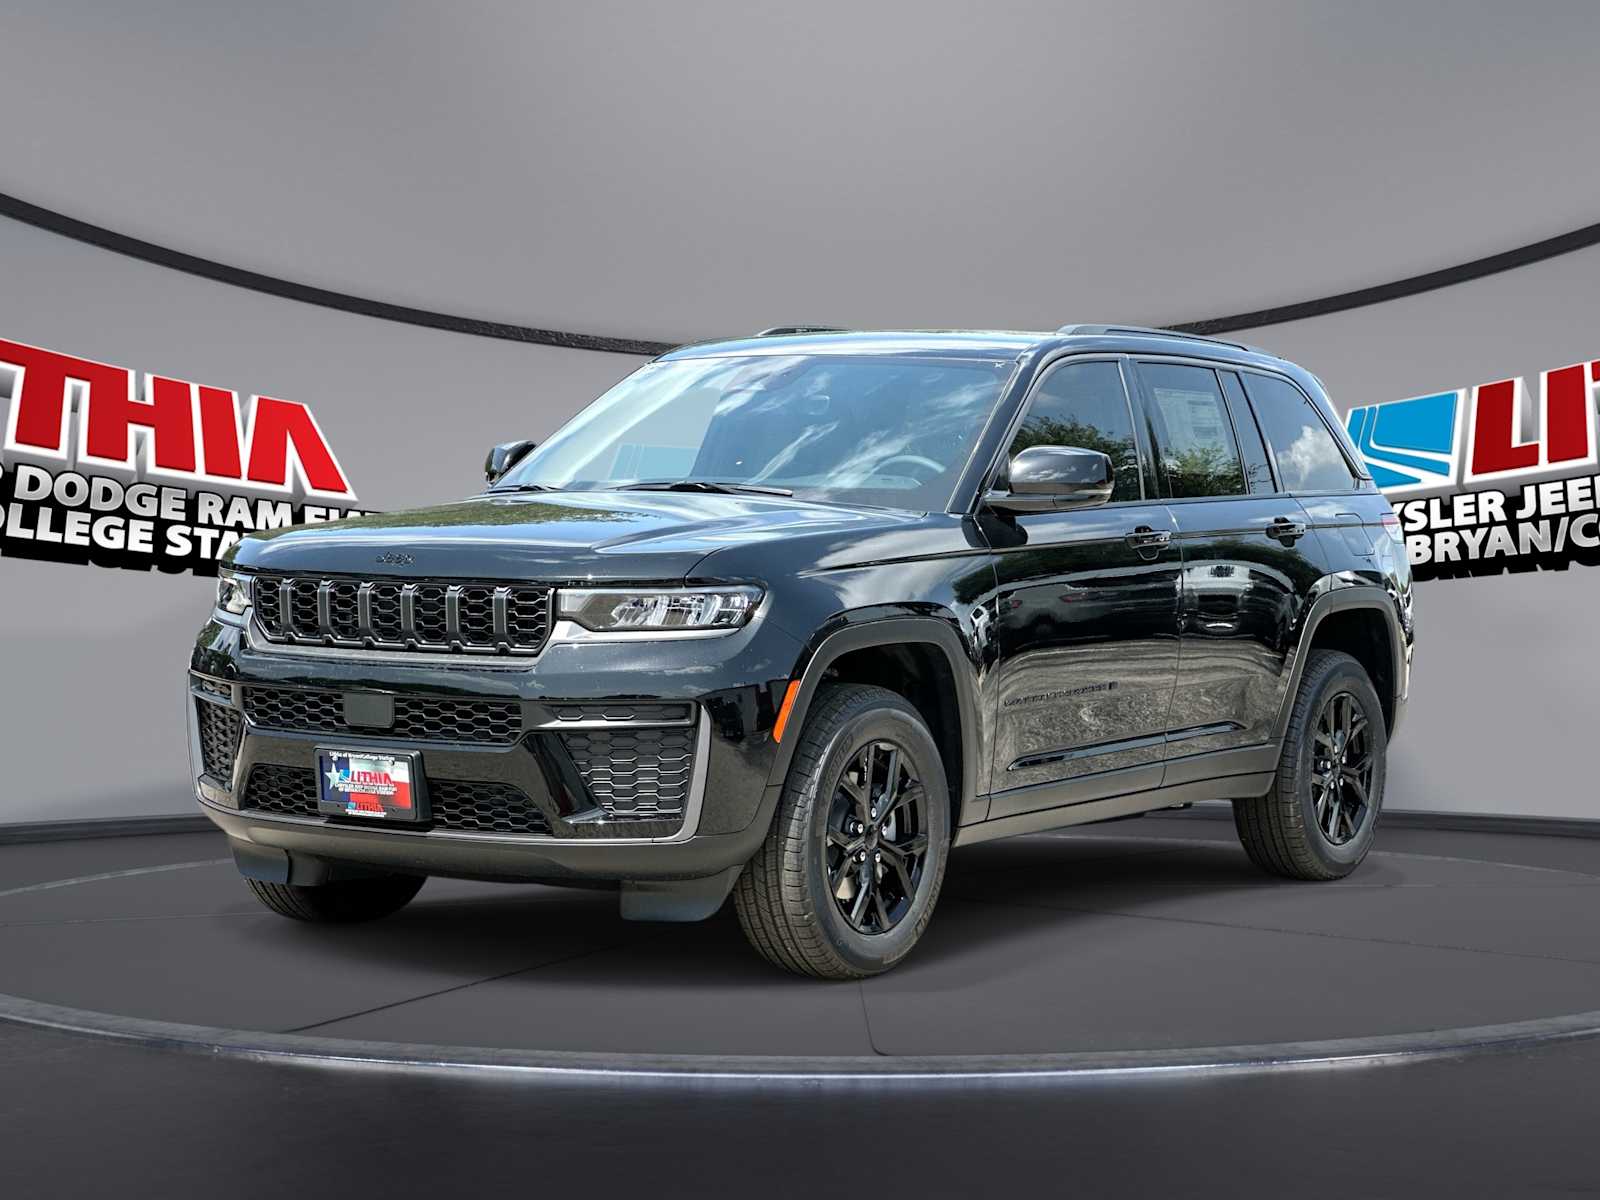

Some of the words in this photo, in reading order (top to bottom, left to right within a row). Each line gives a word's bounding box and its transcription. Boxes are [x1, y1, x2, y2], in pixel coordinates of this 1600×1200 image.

[1463, 359, 1600, 483] LI
[14, 464, 187, 522] DODGE
[197, 492, 293, 531] RAM
[1515, 475, 1600, 520] JEE
[0, 502, 155, 553] LLEGE
[1405, 513, 1600, 566] BRYAN/C
[350, 770, 393, 784] LITHIA
